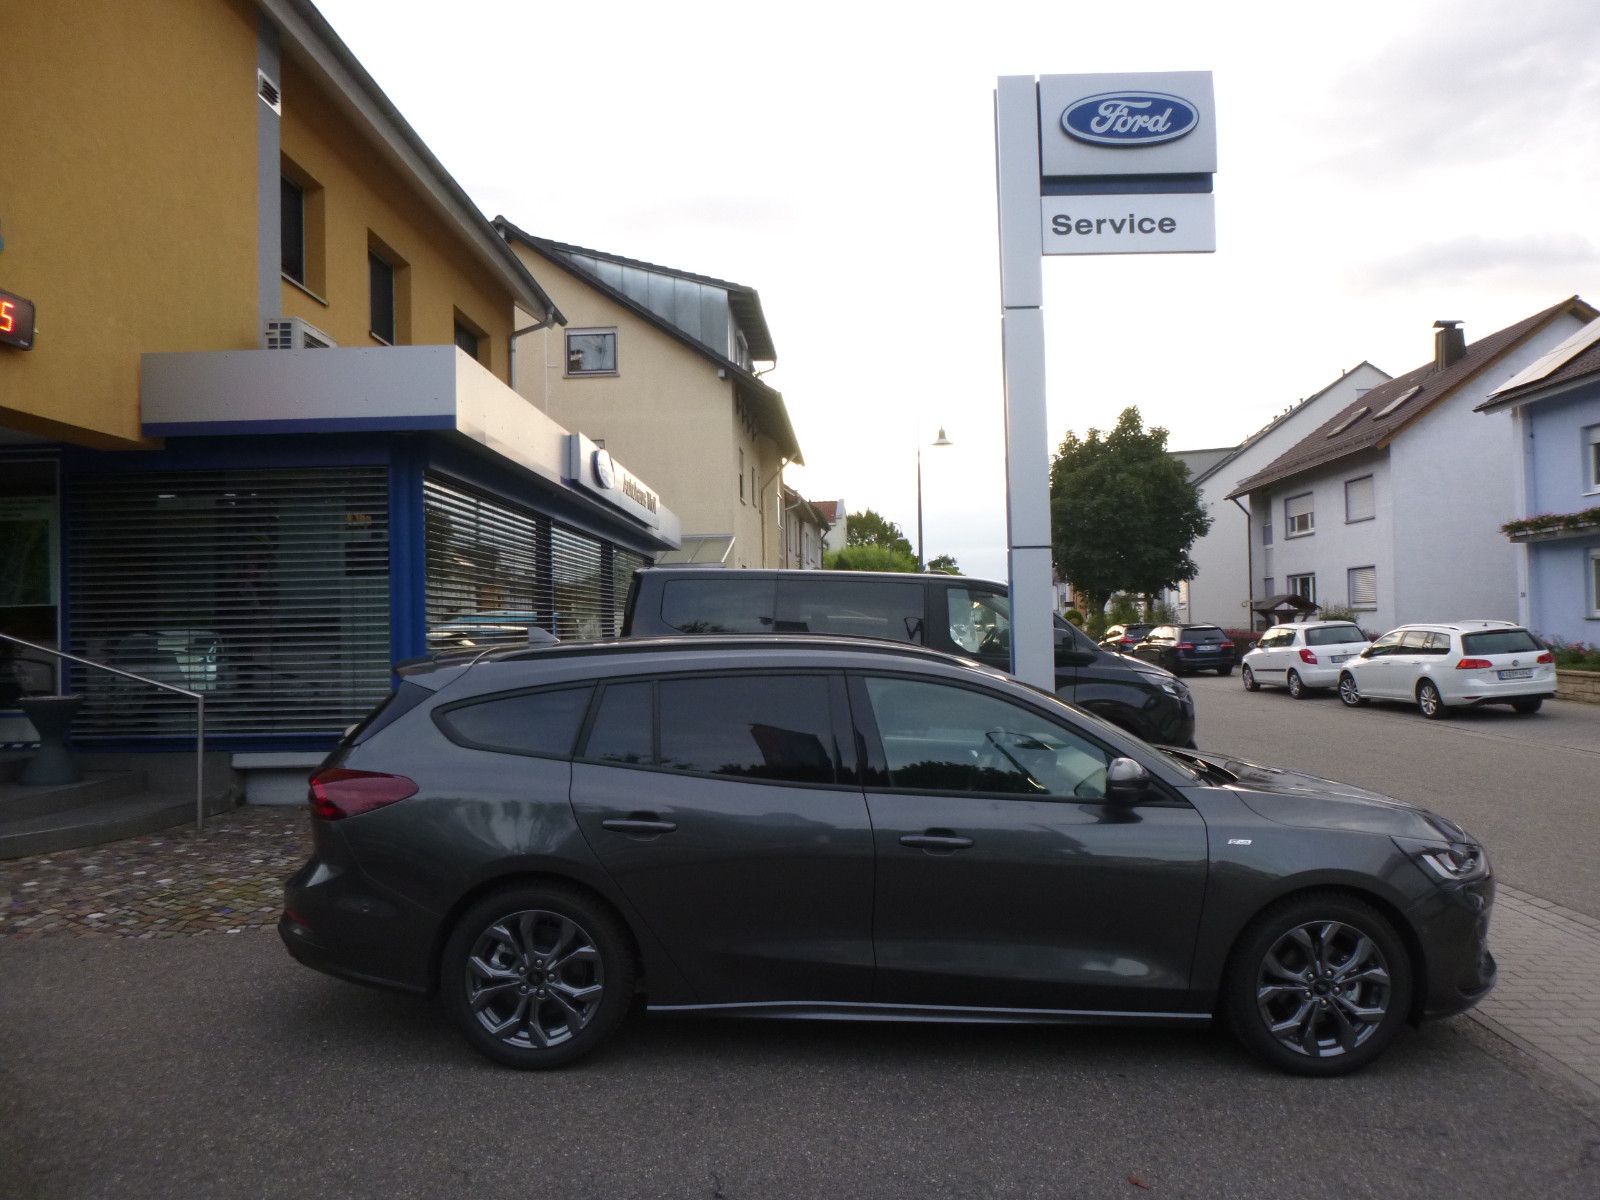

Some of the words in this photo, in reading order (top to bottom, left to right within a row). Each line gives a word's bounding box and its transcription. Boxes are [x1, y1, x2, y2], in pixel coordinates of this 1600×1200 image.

[1091, 100, 1172, 134] Ford
[1051, 213, 1177, 236] Service
[0, 301, 15, 332] 5
